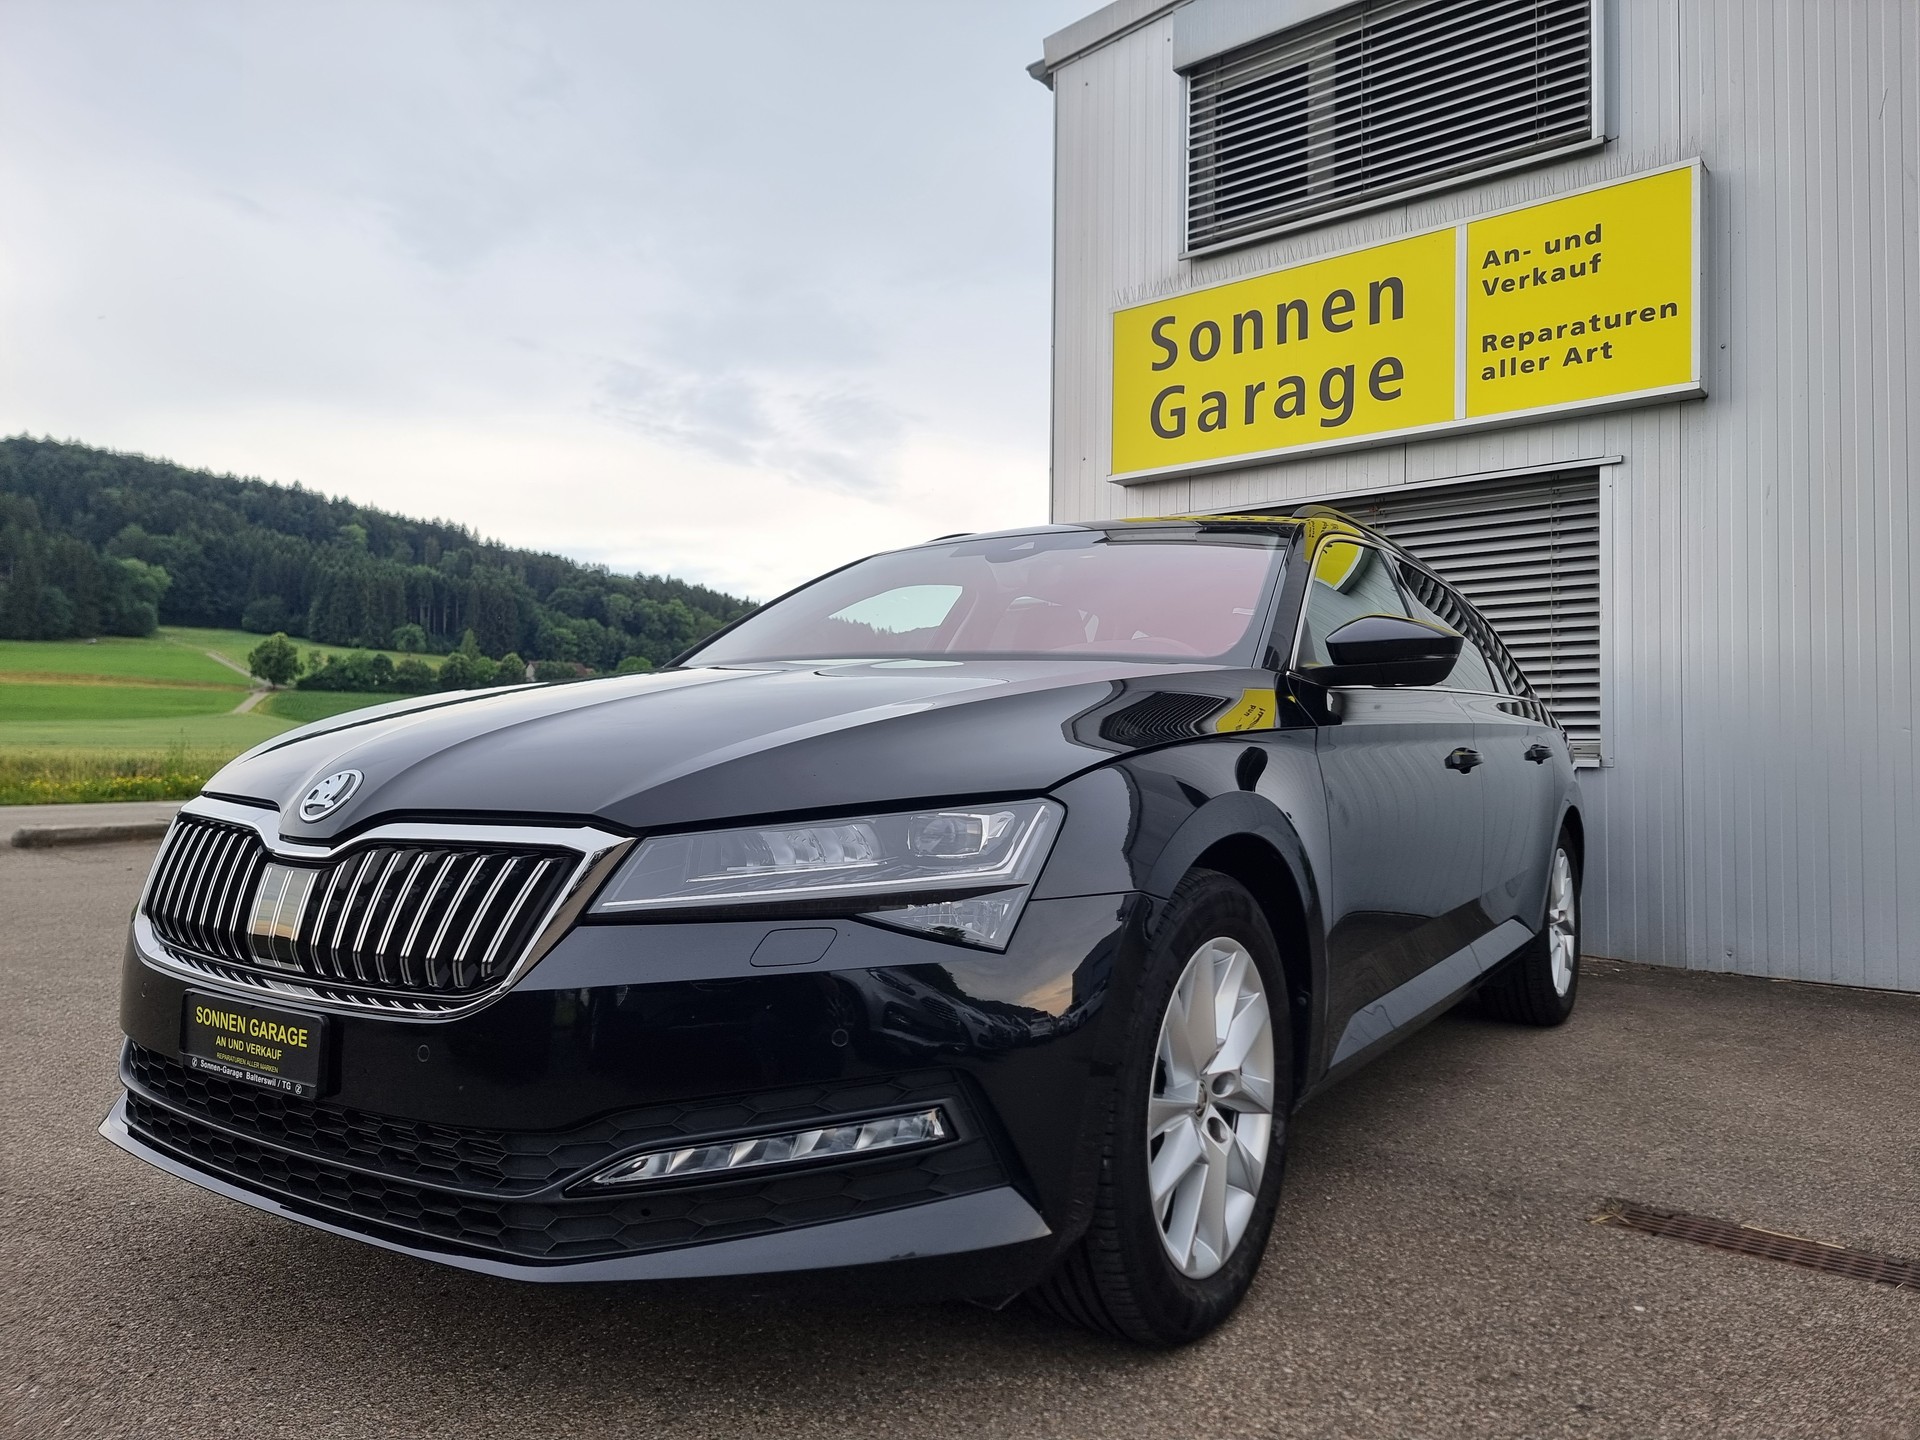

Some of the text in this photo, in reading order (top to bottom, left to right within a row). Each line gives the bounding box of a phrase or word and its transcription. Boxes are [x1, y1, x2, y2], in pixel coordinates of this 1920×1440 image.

[1482, 223, 1602, 269] An- und
[1482, 252, 1602, 296] Verkauf
[1151, 276, 1404, 371] Sonnen
[1482, 302, 1678, 353] Reparaturen
[1481, 341, 1613, 381] aller Art
[1150, 356, 1404, 440] Garage
[195, 1006, 308, 1048] SONNEN GARAGE
[215, 1035, 282, 1060] AN UND VERKAUF
[200, 1059, 243, 1079] Sonnen-Garage
[282, 1081, 291, 1090] TG
[216, 1052, 246, 1065] REPARATUREN
[246, 1059, 260, 1068] ALLER
